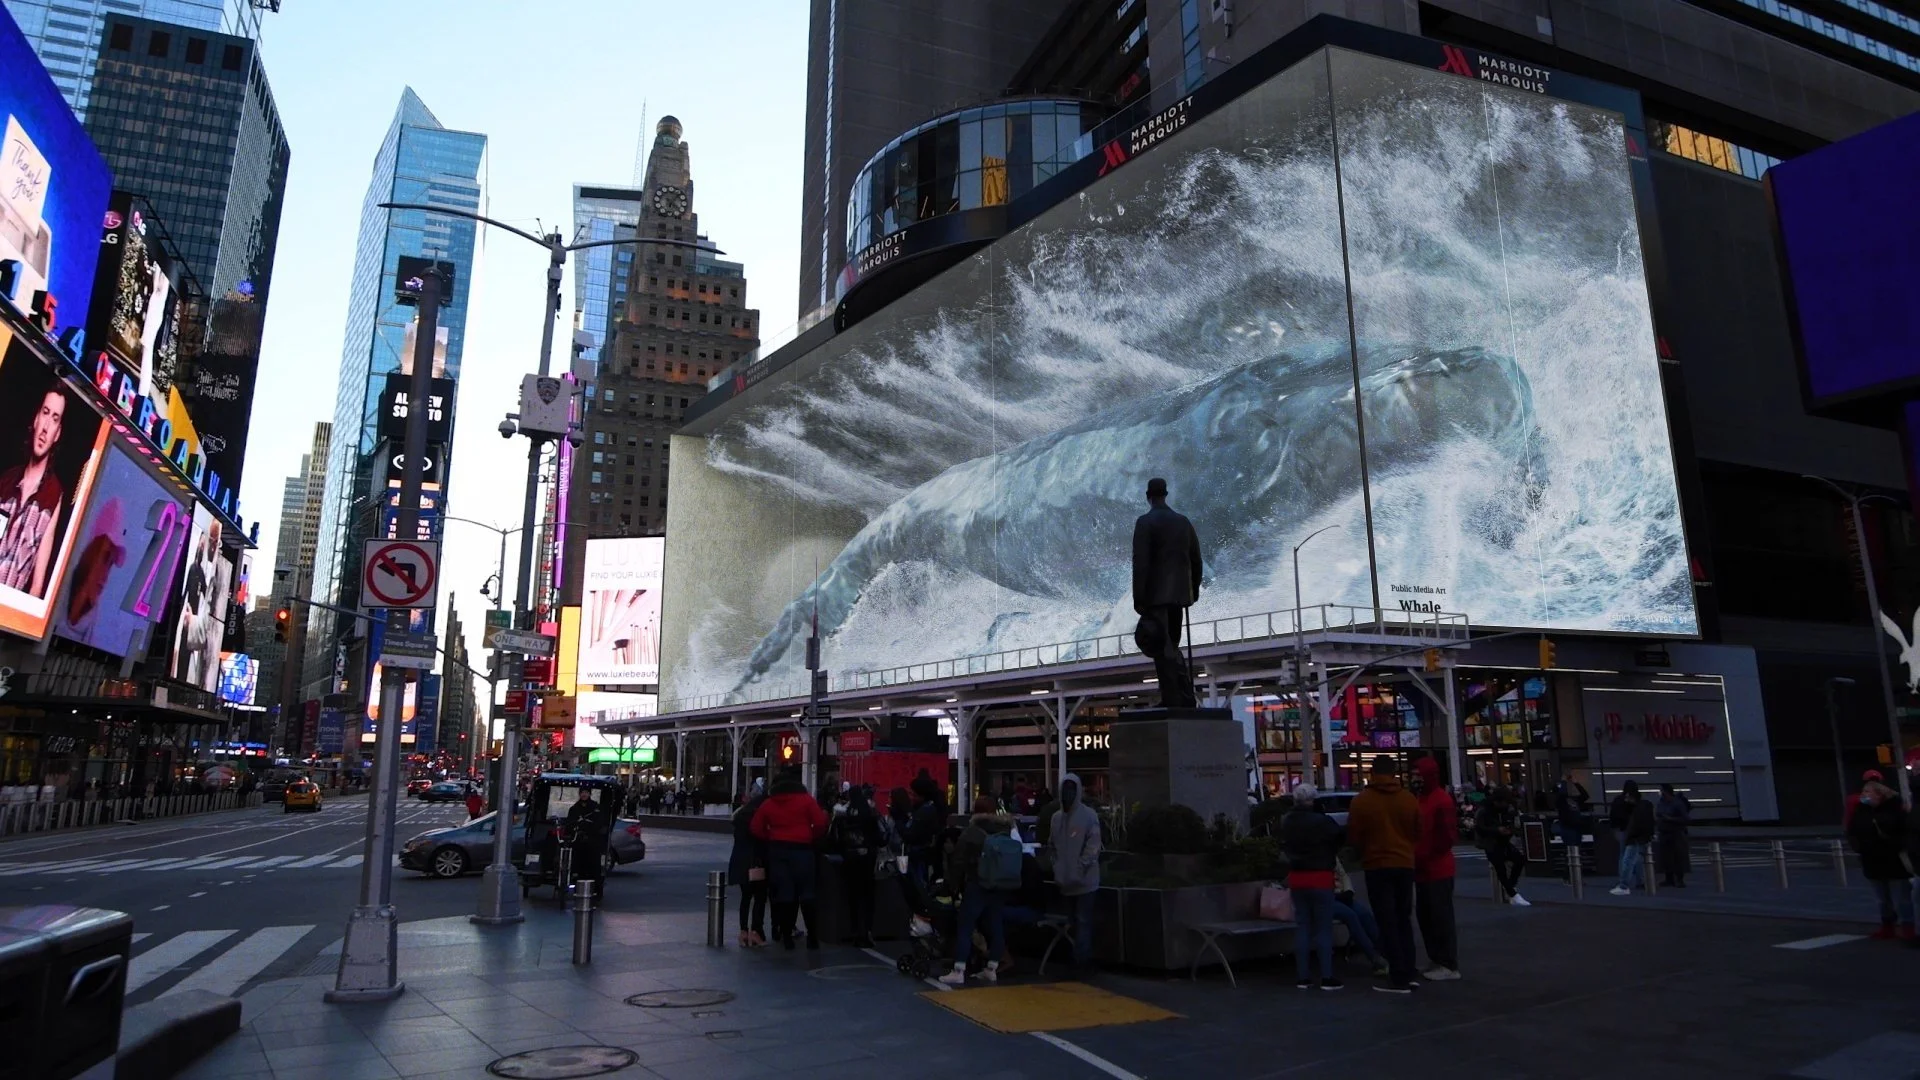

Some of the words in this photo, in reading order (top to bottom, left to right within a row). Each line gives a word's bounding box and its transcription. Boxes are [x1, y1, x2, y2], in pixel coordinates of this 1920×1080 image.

[1478, 55, 1550, 82] MARRIOTT
[1481, 70, 1545, 94] MARQUIS
[1131, 95, 1194, 141] MARRIOTT
[1131, 114, 1186, 154] MARQUIS
[857, 230, 907, 264] MARRIOTT
[857, 246, 900, 277] MARQUIS
[590, 571, 609, 580] FIND
[611, 571, 634, 580] YOUR
[635, 570, 658, 579] LUXIE
[1391, 584, 1412, 593] Public
[1413, 586, 1434, 594] Media
[1435, 587, 1447, 595] Art
[1399, 600, 1442, 613] Whale
[494, 634, 514, 645] ONE
[524, 639, 546, 650] WAY
